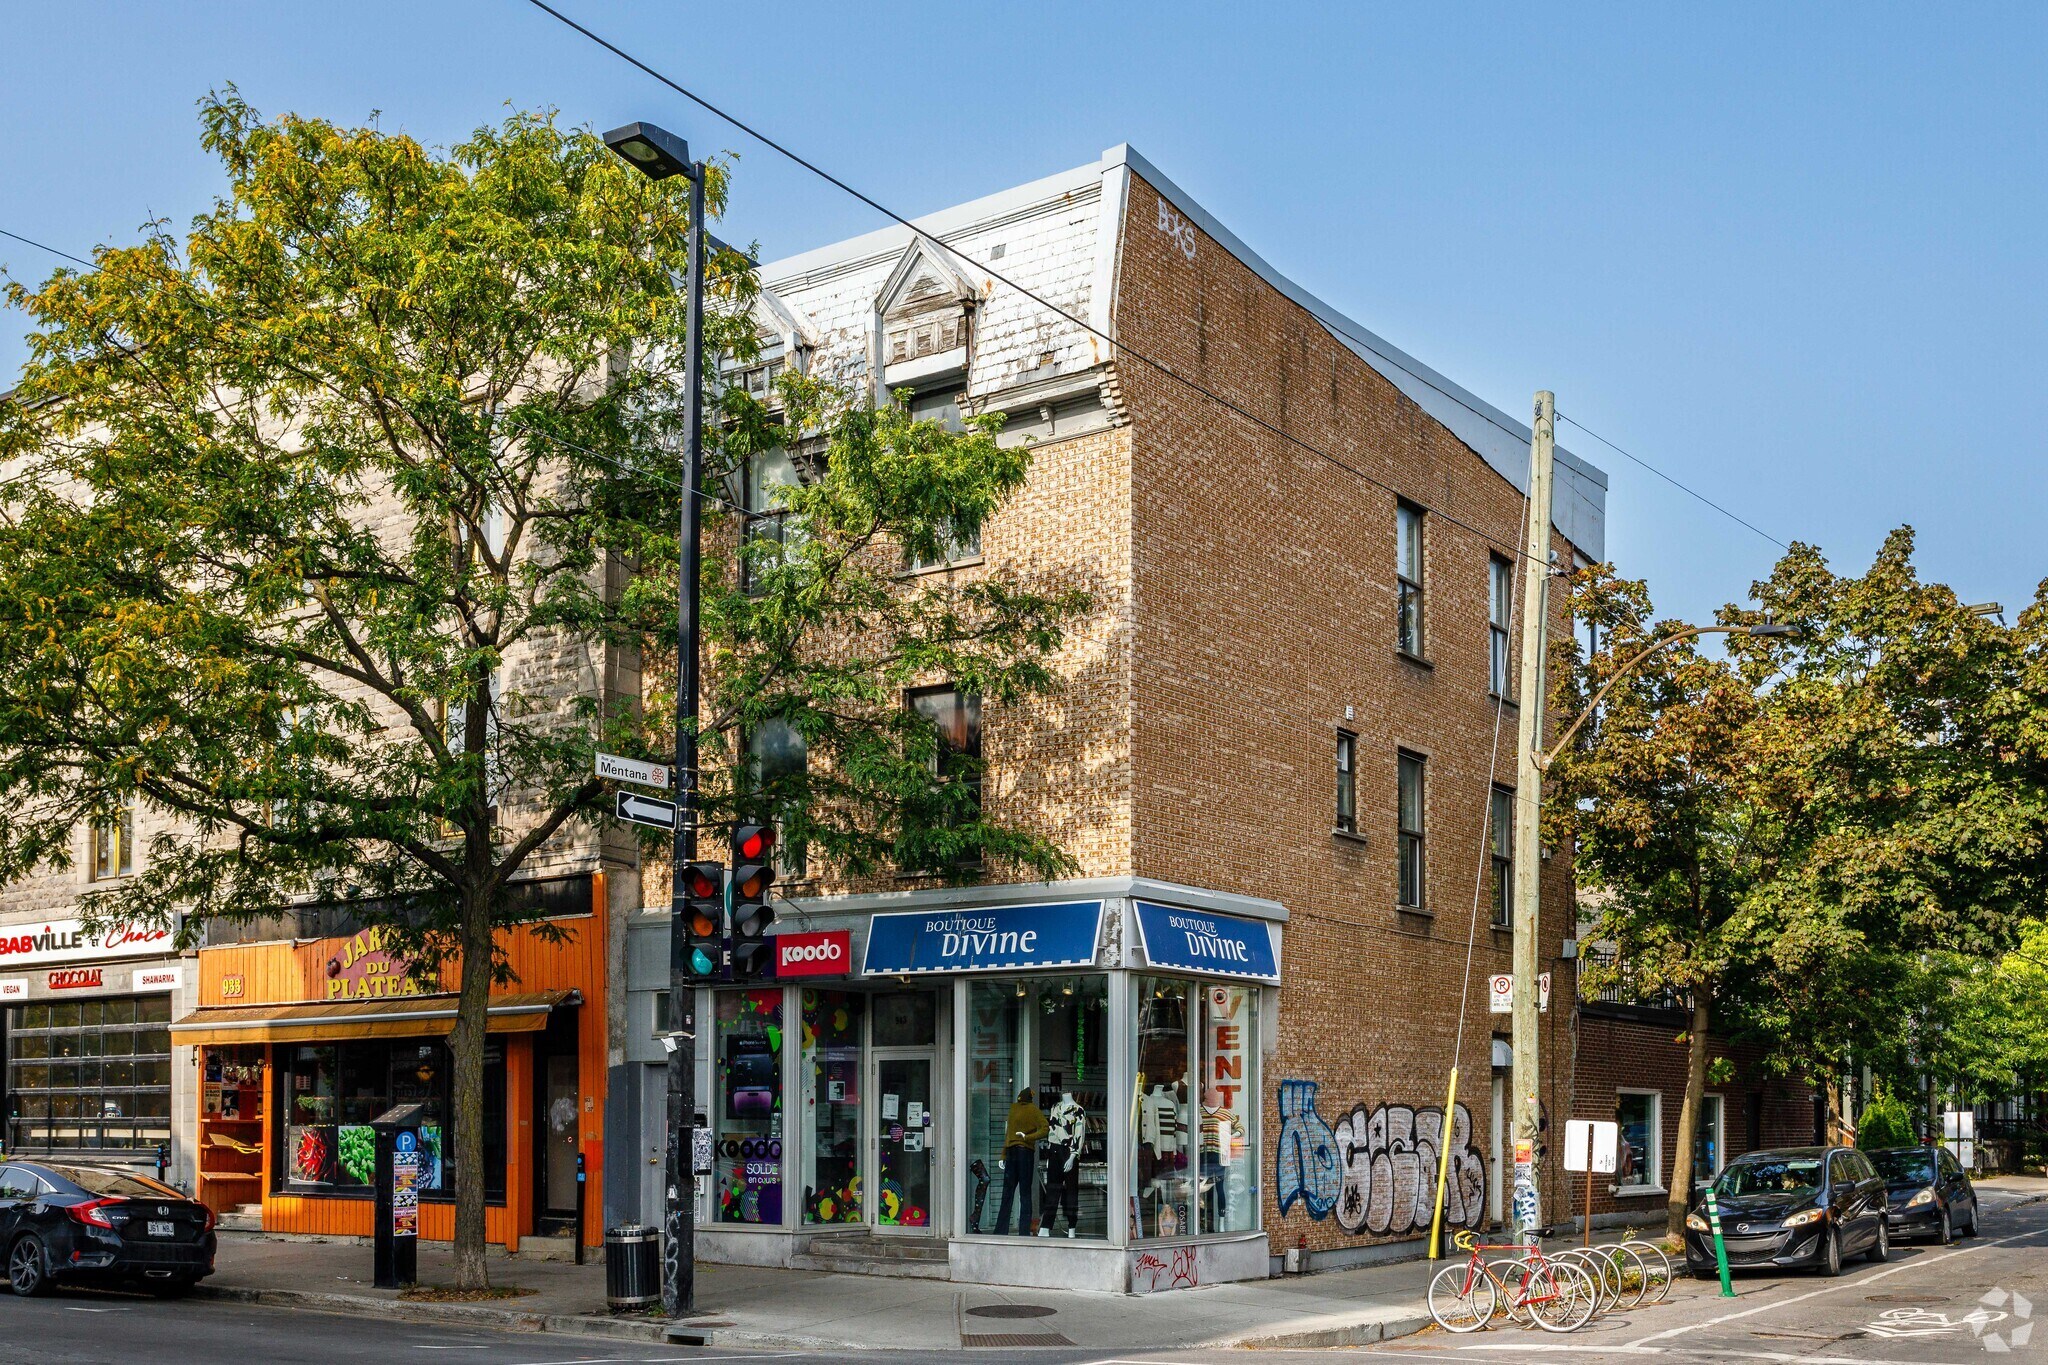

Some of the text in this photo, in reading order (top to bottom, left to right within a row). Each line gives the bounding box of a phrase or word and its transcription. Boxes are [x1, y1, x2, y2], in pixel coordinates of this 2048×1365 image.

[600, 762, 648, 781] Mentana
[925, 917, 997, 933] BOUTIQUE
[1168, 915, 1218, 936] BOUTIQUE
[91, 938, 99, 947] ET
[106, 921, 169, 949] Choco
[343, 924, 420, 969] JAR
[782, 938, 842, 966] koodo
[366, 962, 391, 974] DU
[49, 969, 103, 986] CHOCOLAT
[142, 974, 175, 985] SHAWARMA
[222, 978, 242, 995] 933
[3, 985, 21, 994] VEGAN
[1205, 994, 1244, 1121] VENT
[714, 1133, 783, 1161] koodo
[746, 1163, 778, 1175] SOLDE
